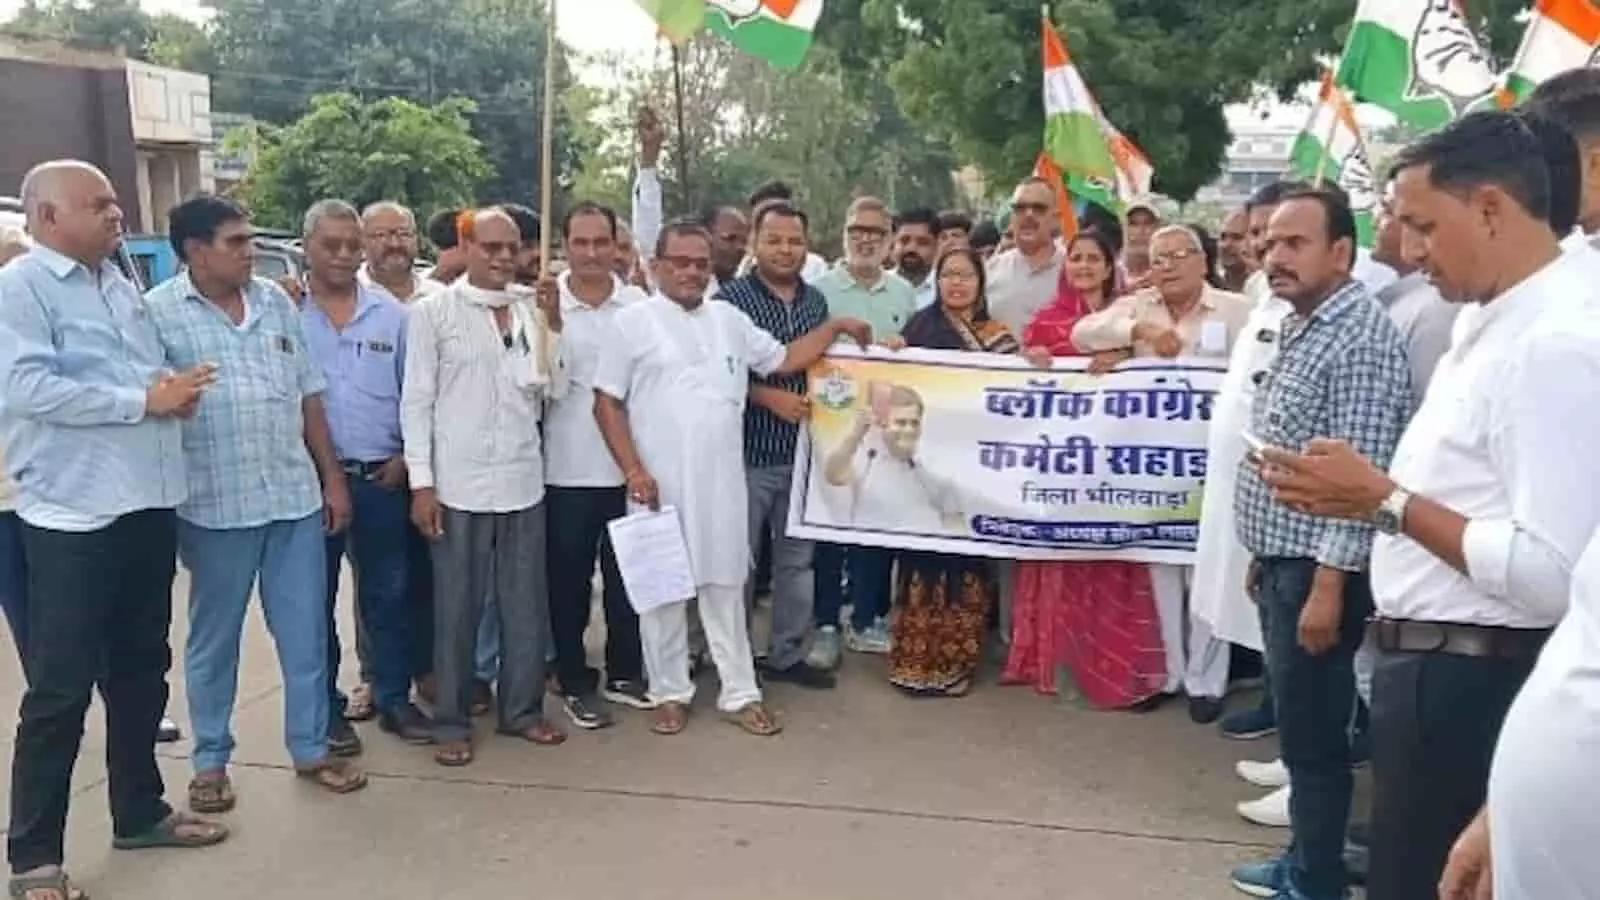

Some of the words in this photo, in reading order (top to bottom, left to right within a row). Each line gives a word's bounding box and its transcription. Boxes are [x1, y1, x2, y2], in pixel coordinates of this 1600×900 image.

[984, 380, 1097, 419] ब्लॉक
[978, 434, 1098, 475] कमेटी
[1105, 445, 1208, 485] सहाड़
[1021, 481, 1079, 504] जिला
[1085, 481, 1189, 509] भीलवाड़ा
